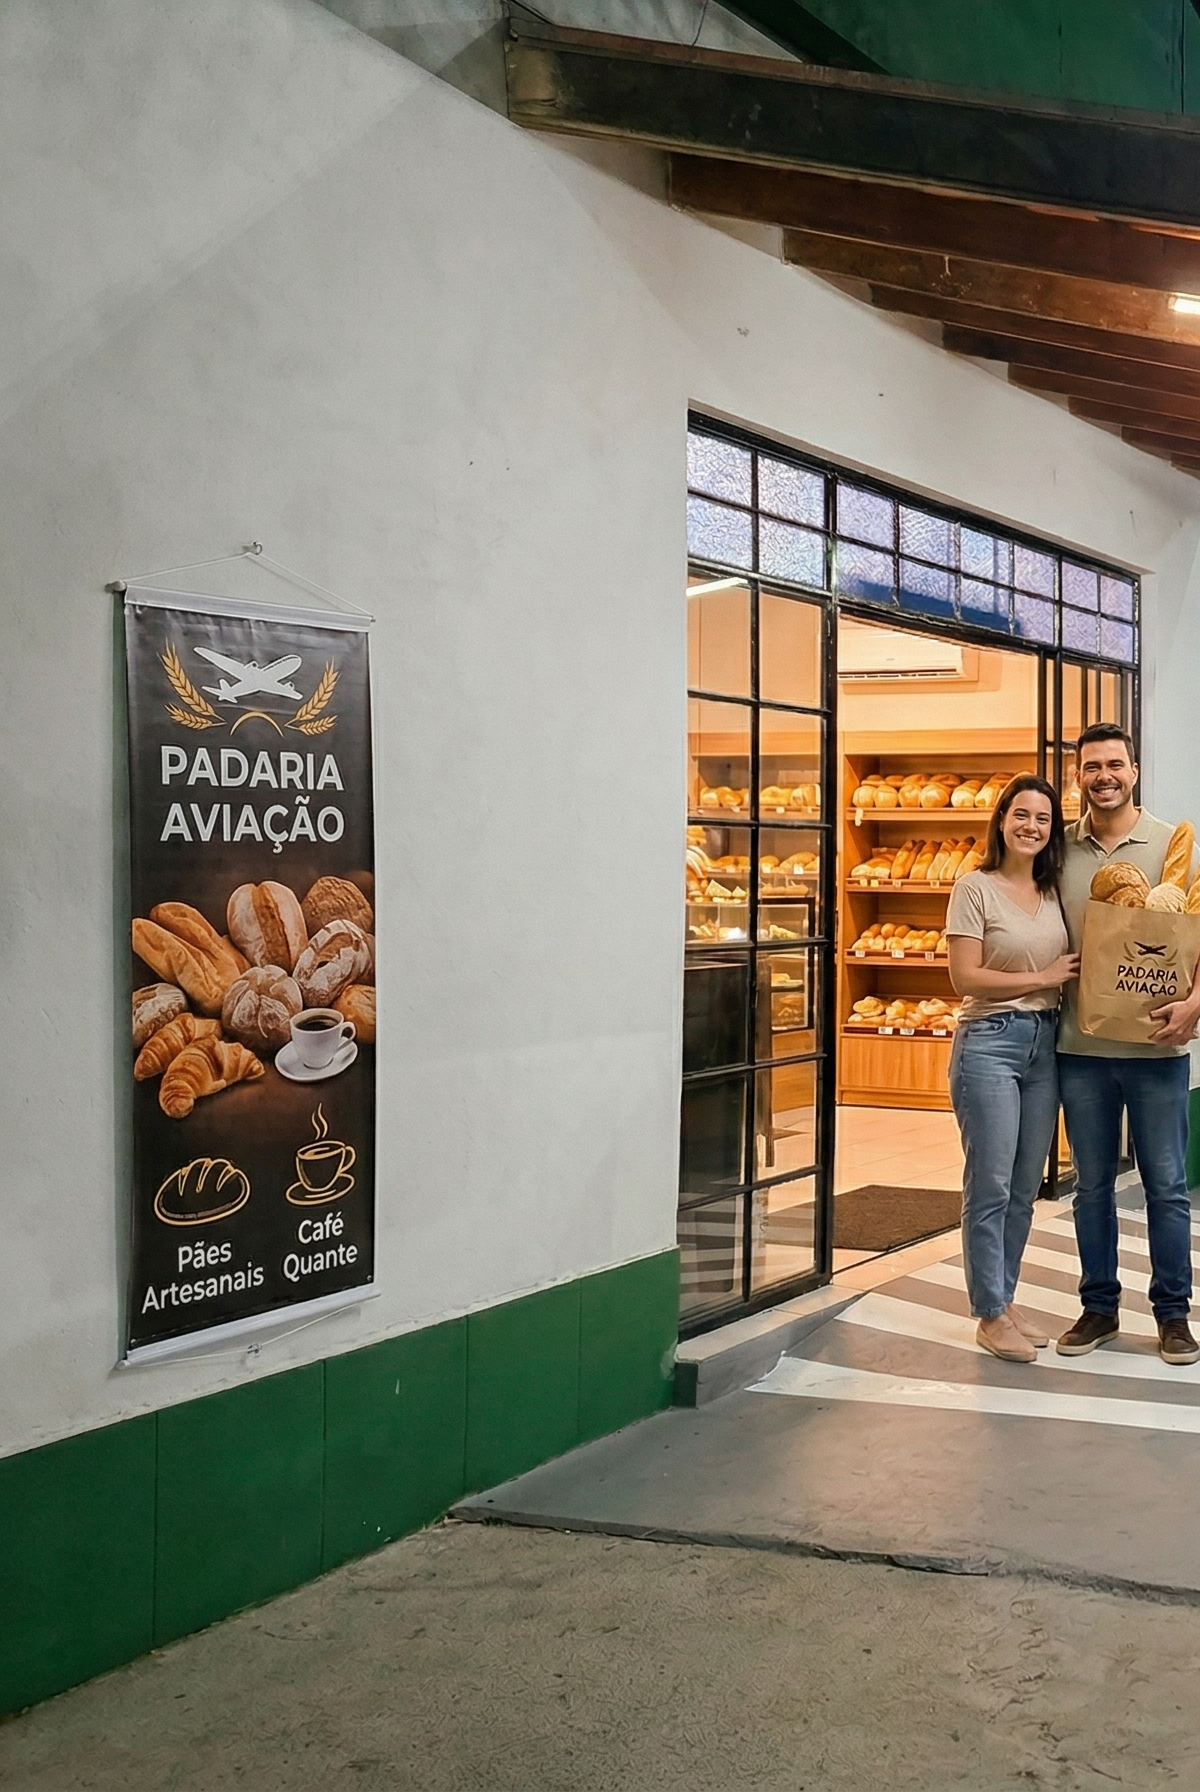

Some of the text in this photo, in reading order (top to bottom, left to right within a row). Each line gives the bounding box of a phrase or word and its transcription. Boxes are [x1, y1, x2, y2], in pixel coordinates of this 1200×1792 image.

[160, 745, 345, 791] PADARIA
[160, 795, 345, 853] AVIAÇÃO
[1117, 965, 1178, 983] PADARIA
[298, 1211, 344, 1244] Café
[177, 1241, 232, 1273] Pães
[283, 1243, 358, 1282] Quante
[141, 1262, 264, 1314] Artesanais
